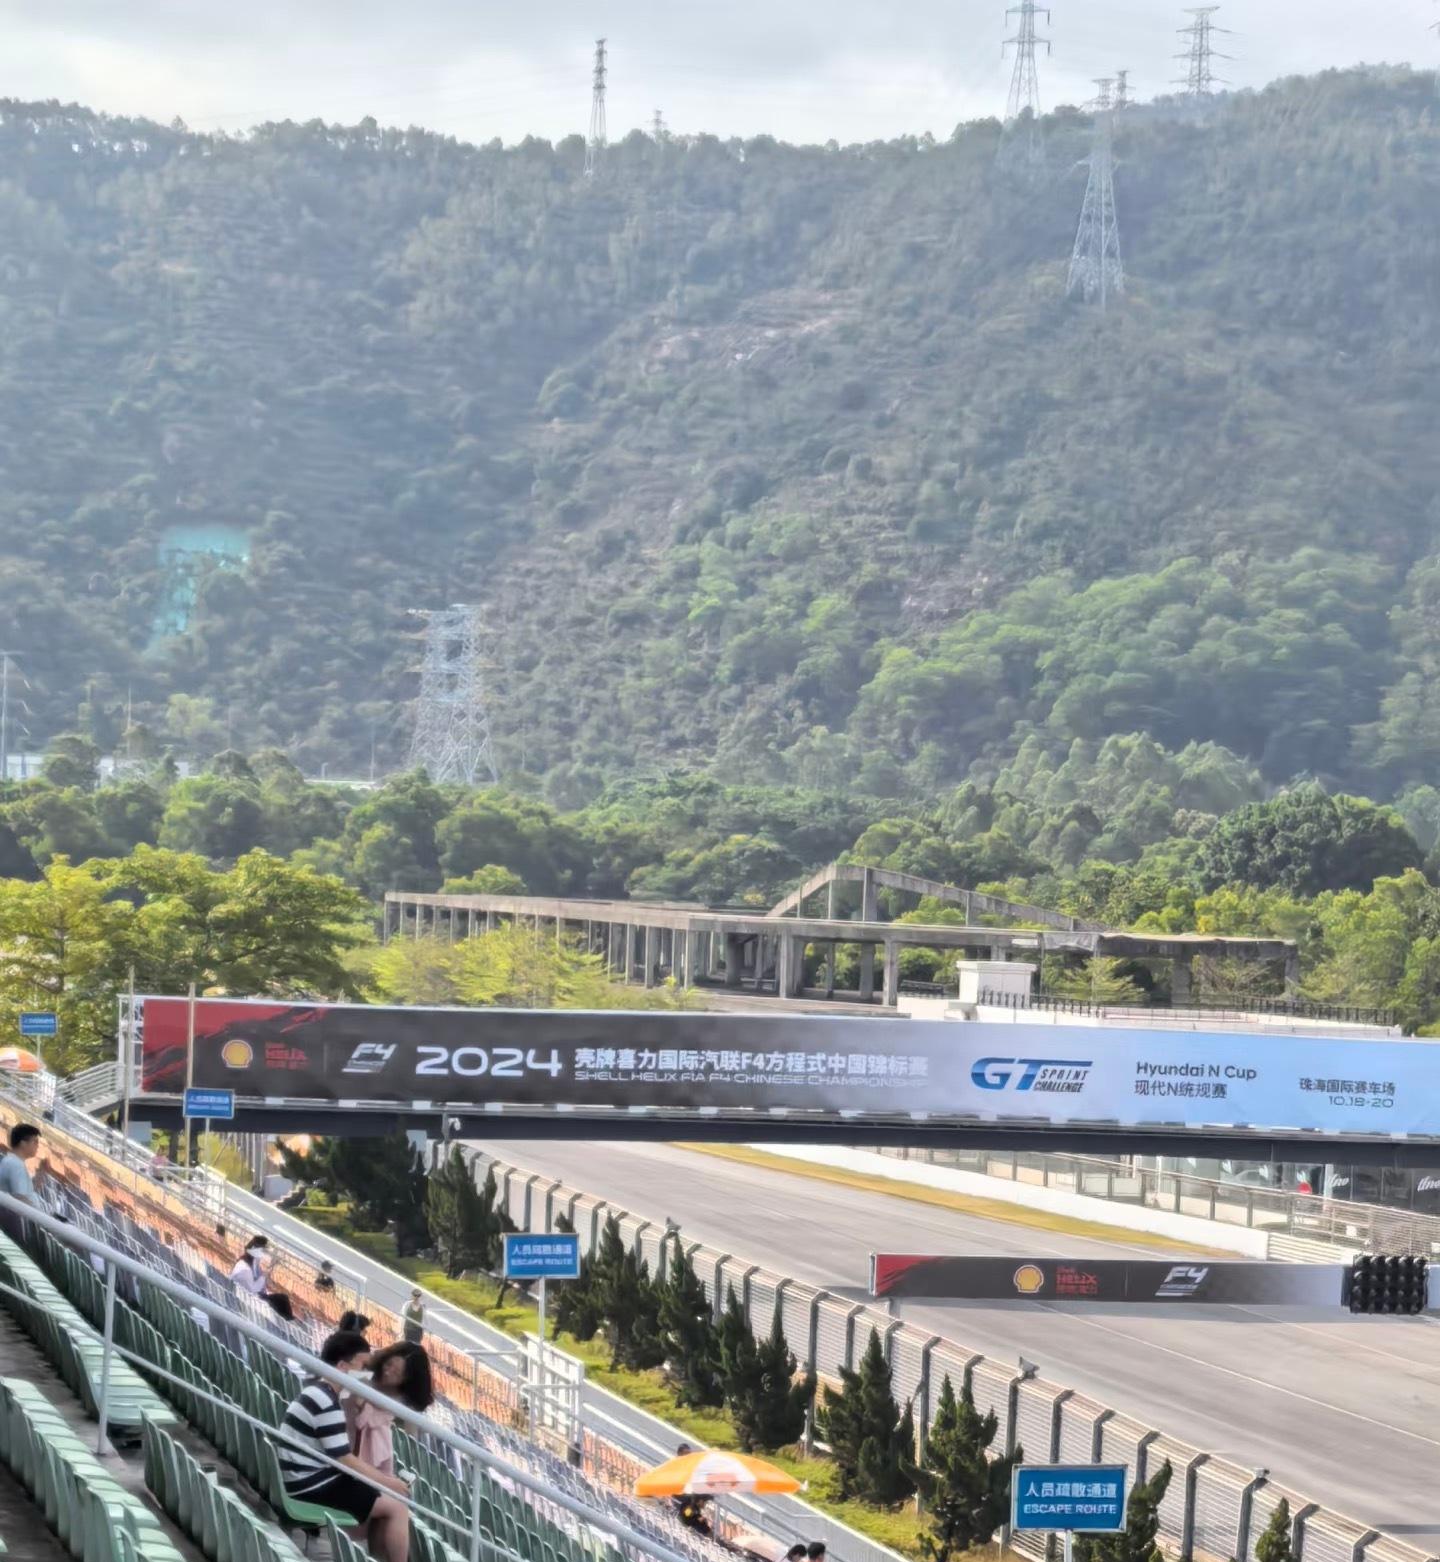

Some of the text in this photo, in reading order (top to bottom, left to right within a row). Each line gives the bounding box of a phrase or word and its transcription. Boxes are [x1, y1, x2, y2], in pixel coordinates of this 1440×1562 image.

[352, 1043, 397, 1060] F4
[415, 1046, 563, 1077] 2024
[575, 1071, 628, 1081] SHELL
[631, 1072, 677, 1082] HELIX
[681, 1073, 706, 1082] FIA
[709, 1073, 731, 1082] F4
[733, 1073, 804, 1084] CHINESE
[971, 1057, 1093, 1090] GT
[1040, 1068, 1089, 1081] SPRINT
[1136, 1061, 1257, 1080] Hyundai N Cup
[1033, 1081, 1085, 1093] CHALLENGE
[1135, 1080, 1227, 1099] 现代N统规赛
[1299, 1078, 1395, 1096] 珠海国际赛车场
[1164, 1267, 1208, 1283] F4
[1025, 1481, 1117, 1498] 人员疏散通道
[1024, 1504, 1116, 1514] ESCAPE ROUTE
